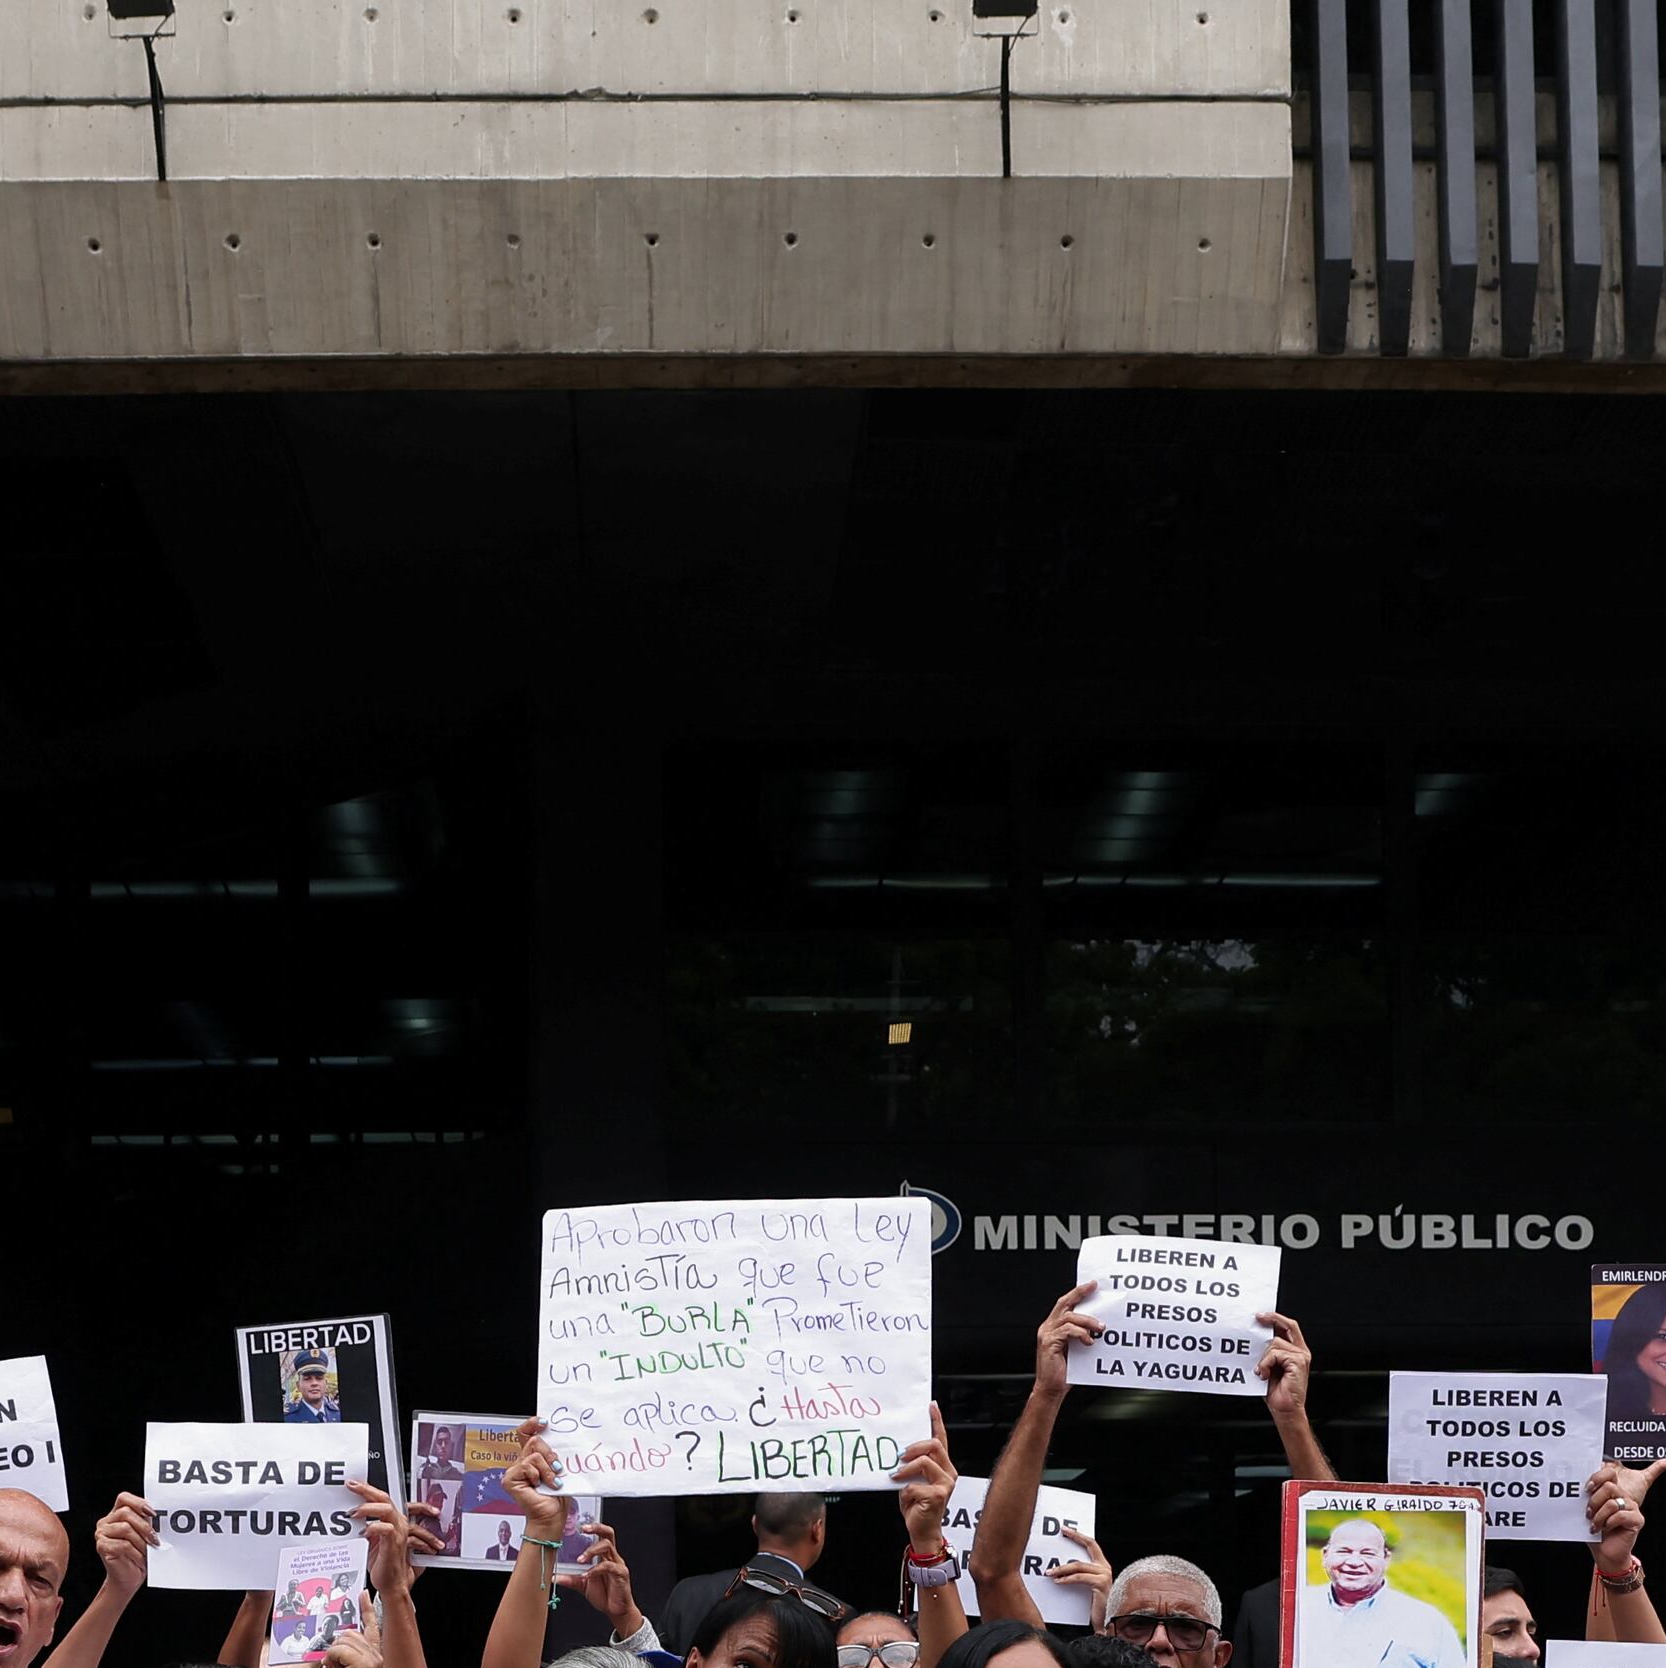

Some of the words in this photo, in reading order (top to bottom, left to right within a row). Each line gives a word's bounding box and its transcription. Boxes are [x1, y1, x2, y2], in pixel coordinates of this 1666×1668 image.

[974, 1213, 1320, 1250] MINISTERIO
[1341, 1203, 1595, 1251] PÚBLICO
[1116, 1248, 1216, 1268] LIBEREN
[1223, 1256, 1239, 1270] A
[738, 1257, 795, 1298] que
[816, 1252, 885, 1298] fue
[1109, 1274, 1188, 1294] TODOS
[1195, 1280, 1241, 1298] LOS
[1125, 1302, 1218, 1324] PRESOS
[549, 1313, 615, 1340] una
[250, 1323, 371, 1355] LIBERTAD
[1220, 1338, 1251, 1355] DE
[766, 1349, 825, 1386] que
[841, 1355, 886, 1375] no
[1096, 1358, 1125, 1376] LA
[1133, 1361, 1247, 1384] YAGUARA
[1432, 1389, 1538, 1406] LIBEREN
[1545, 1390, 1563, 1407] A
[1426, 1420, 1511, 1437] TODOS
[1519, 1420, 1566, 1437] LOS
[1609, 1420, 1666, 1432] RECLUIDA
[470, 1450, 491, 1461] Caso
[494, 1450, 503, 1461] la
[558, 1437, 672, 1478] uándo
[718, 1429, 900, 1482] LIBERTAD
[1447, 1451, 1544, 1468] PRESOS
[1614, 1446, 1654, 1458] DESDE
[158, 1459, 284, 1485] BASTA
[297, 1460, 346, 1486] DE
[1548, 1481, 1581, 1498] DE
[1316, 1498, 1377, 1511] JAVIER
[150, 1509, 353, 1537] TORTURAS
